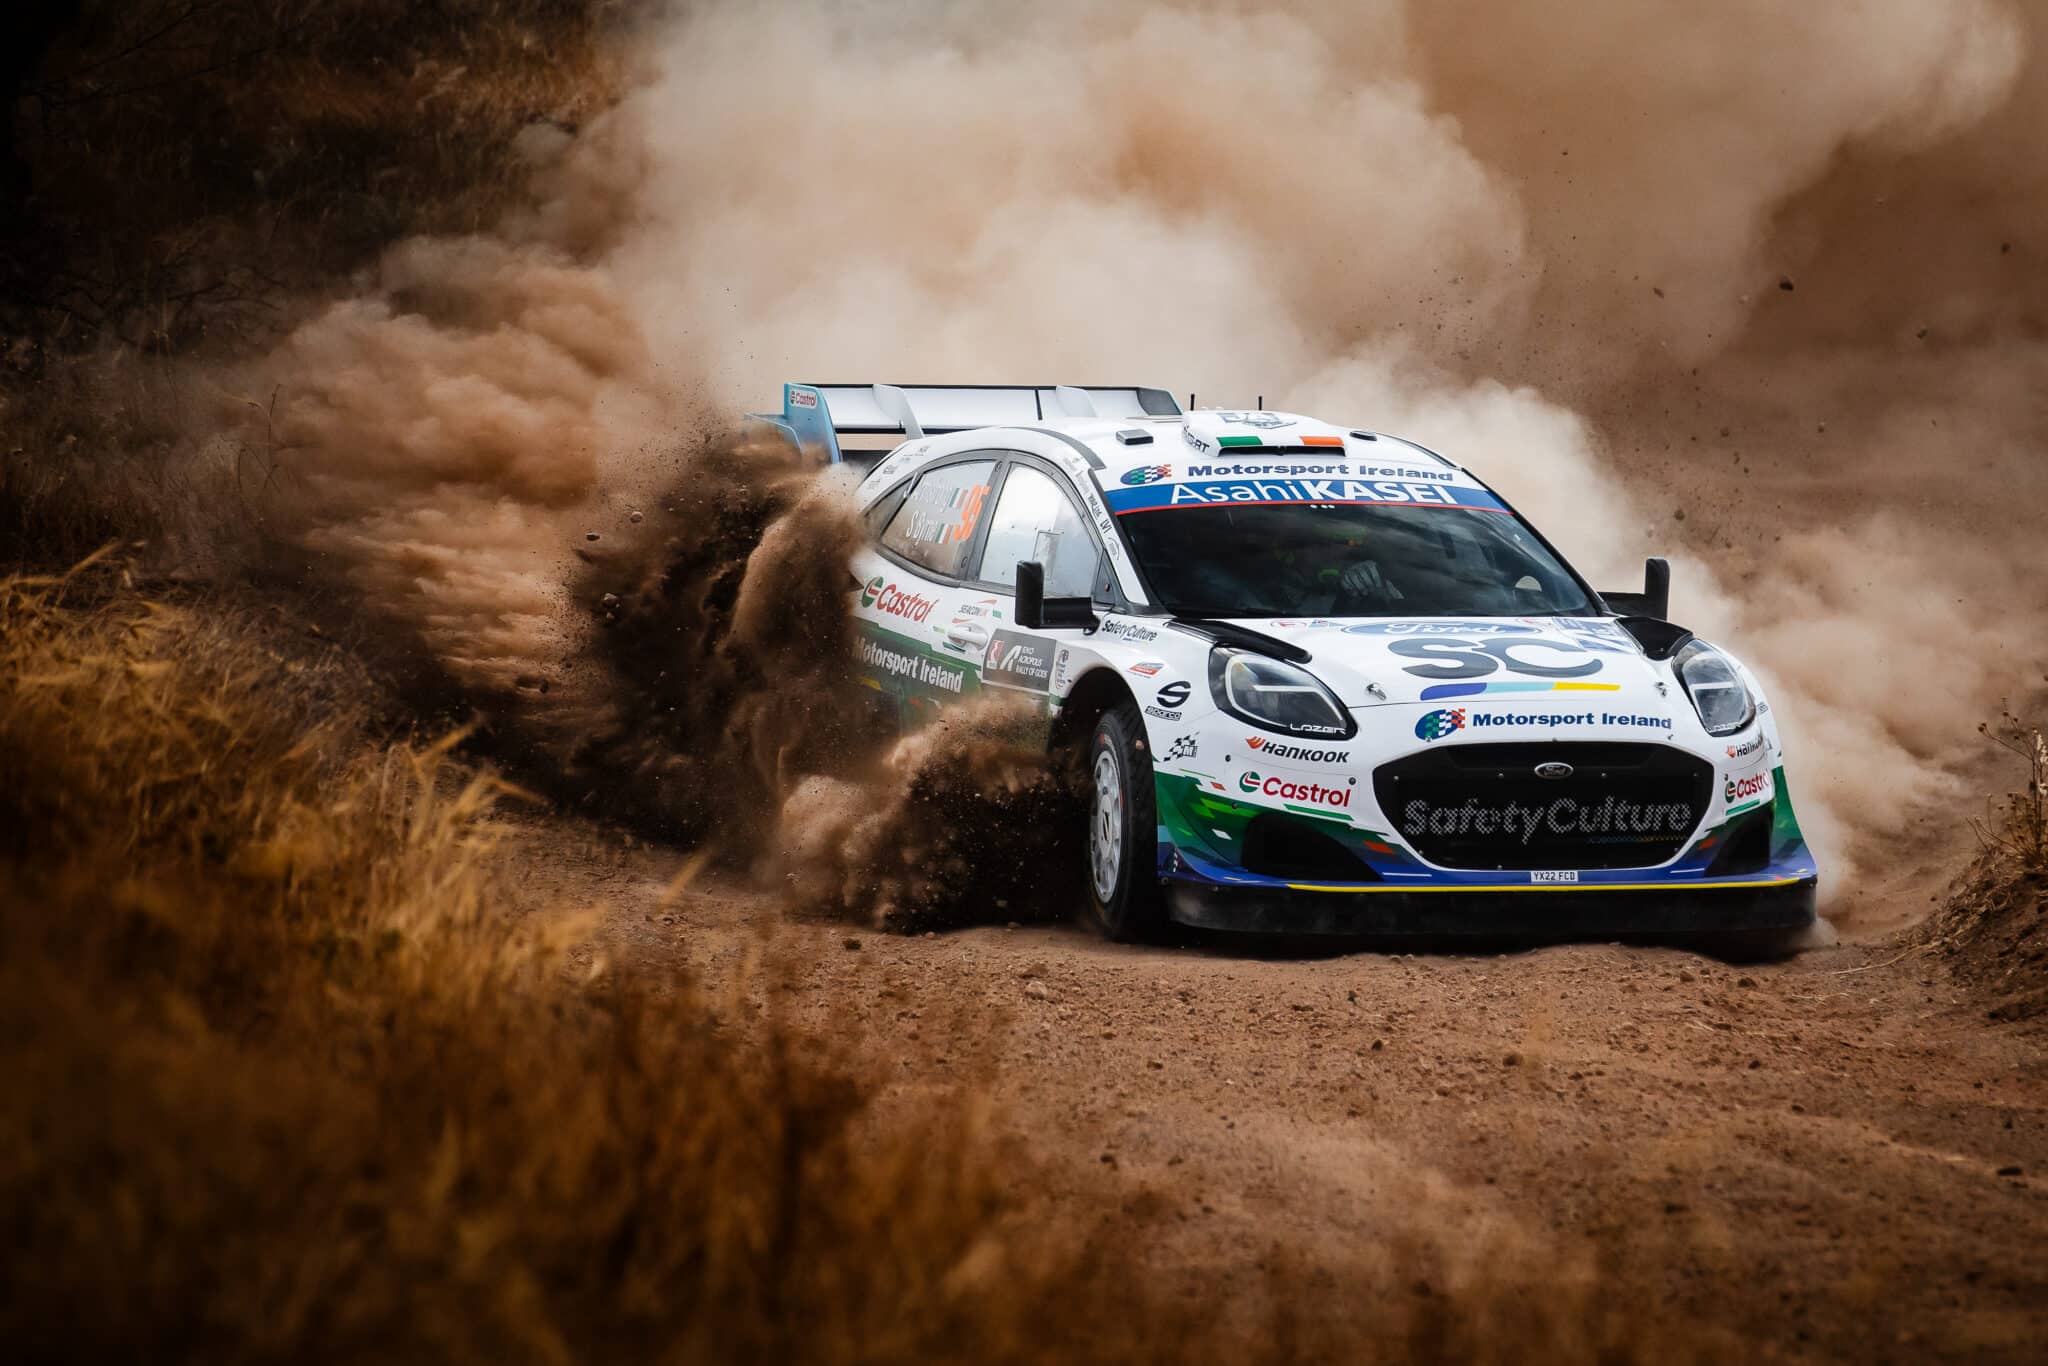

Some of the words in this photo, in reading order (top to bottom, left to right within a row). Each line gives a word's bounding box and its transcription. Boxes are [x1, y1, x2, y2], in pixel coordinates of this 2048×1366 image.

[1188, 463, 1350, 477] Motorsport
[1360, 466, 1453, 481] Ireland
[877, 584, 940, 623] Castrol
[1102, 620, 1158, 642] SafetyCulture
[1383, 622, 1506, 635] Ford
[853, 636, 919, 678] Motorsport
[919, 659, 964, 693] Ireland
[1388, 638, 1604, 679] SC
[1473, 712, 1595, 728] Motorsport
[1602, 713, 1672, 729] Ireland
[1263, 777, 1352, 808] Castrol
[1403, 795, 1692, 845] SafetyCulture
[1533, 871, 1556, 881] YX22
[1558, 871, 1576, 881] FCD
